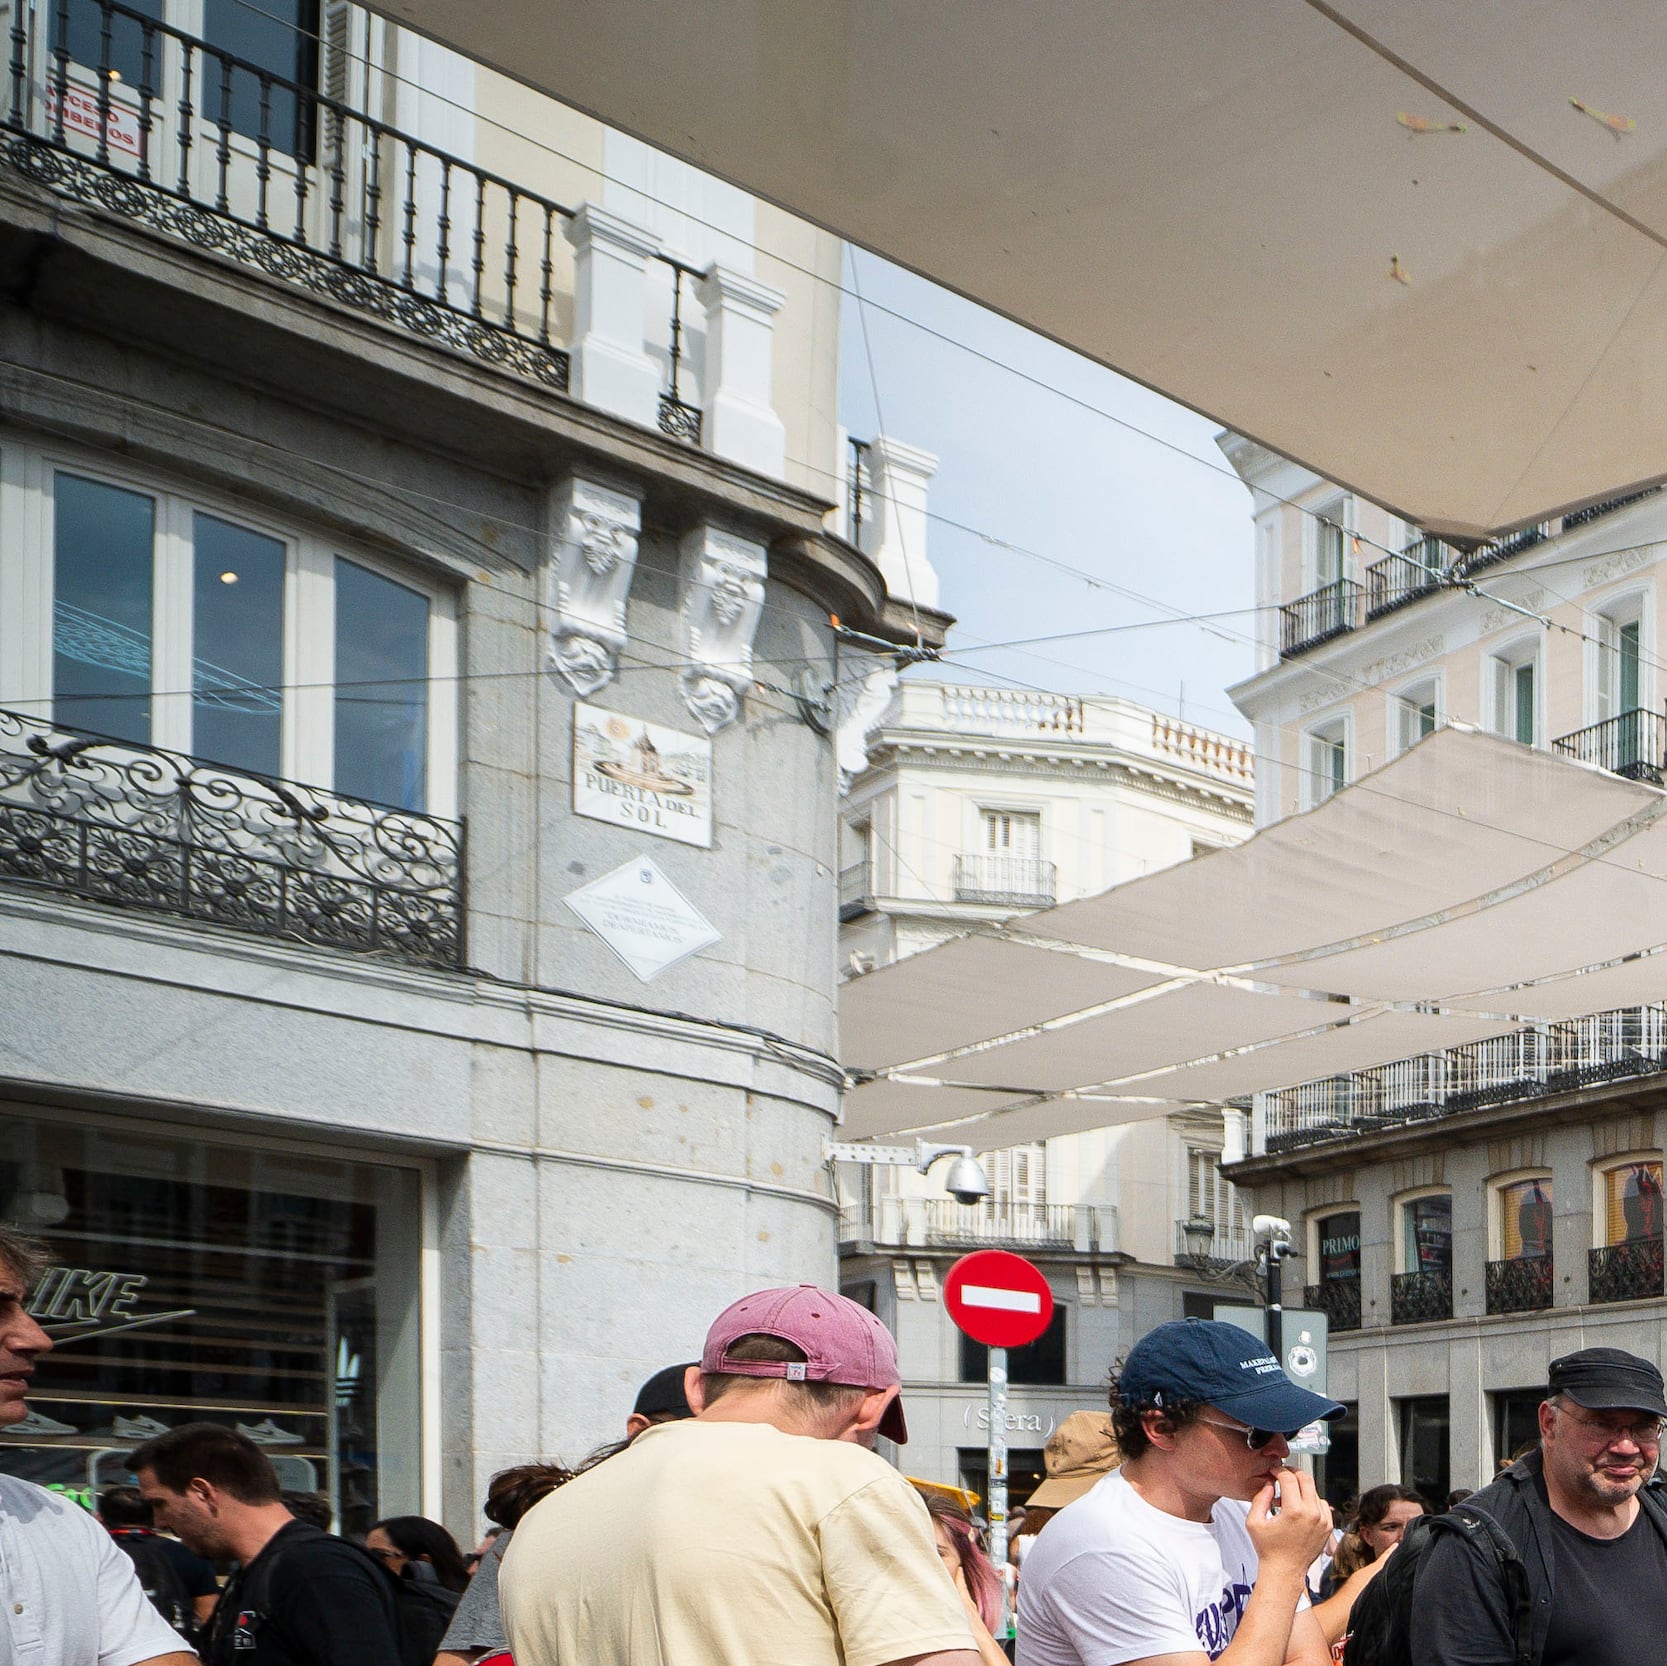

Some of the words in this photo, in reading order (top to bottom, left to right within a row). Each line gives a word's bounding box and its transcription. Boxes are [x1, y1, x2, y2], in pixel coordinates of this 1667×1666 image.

[585, 772, 664, 809] PUERTA
[665, 799, 701, 819] DEL
[621, 801, 667, 828] SOL
